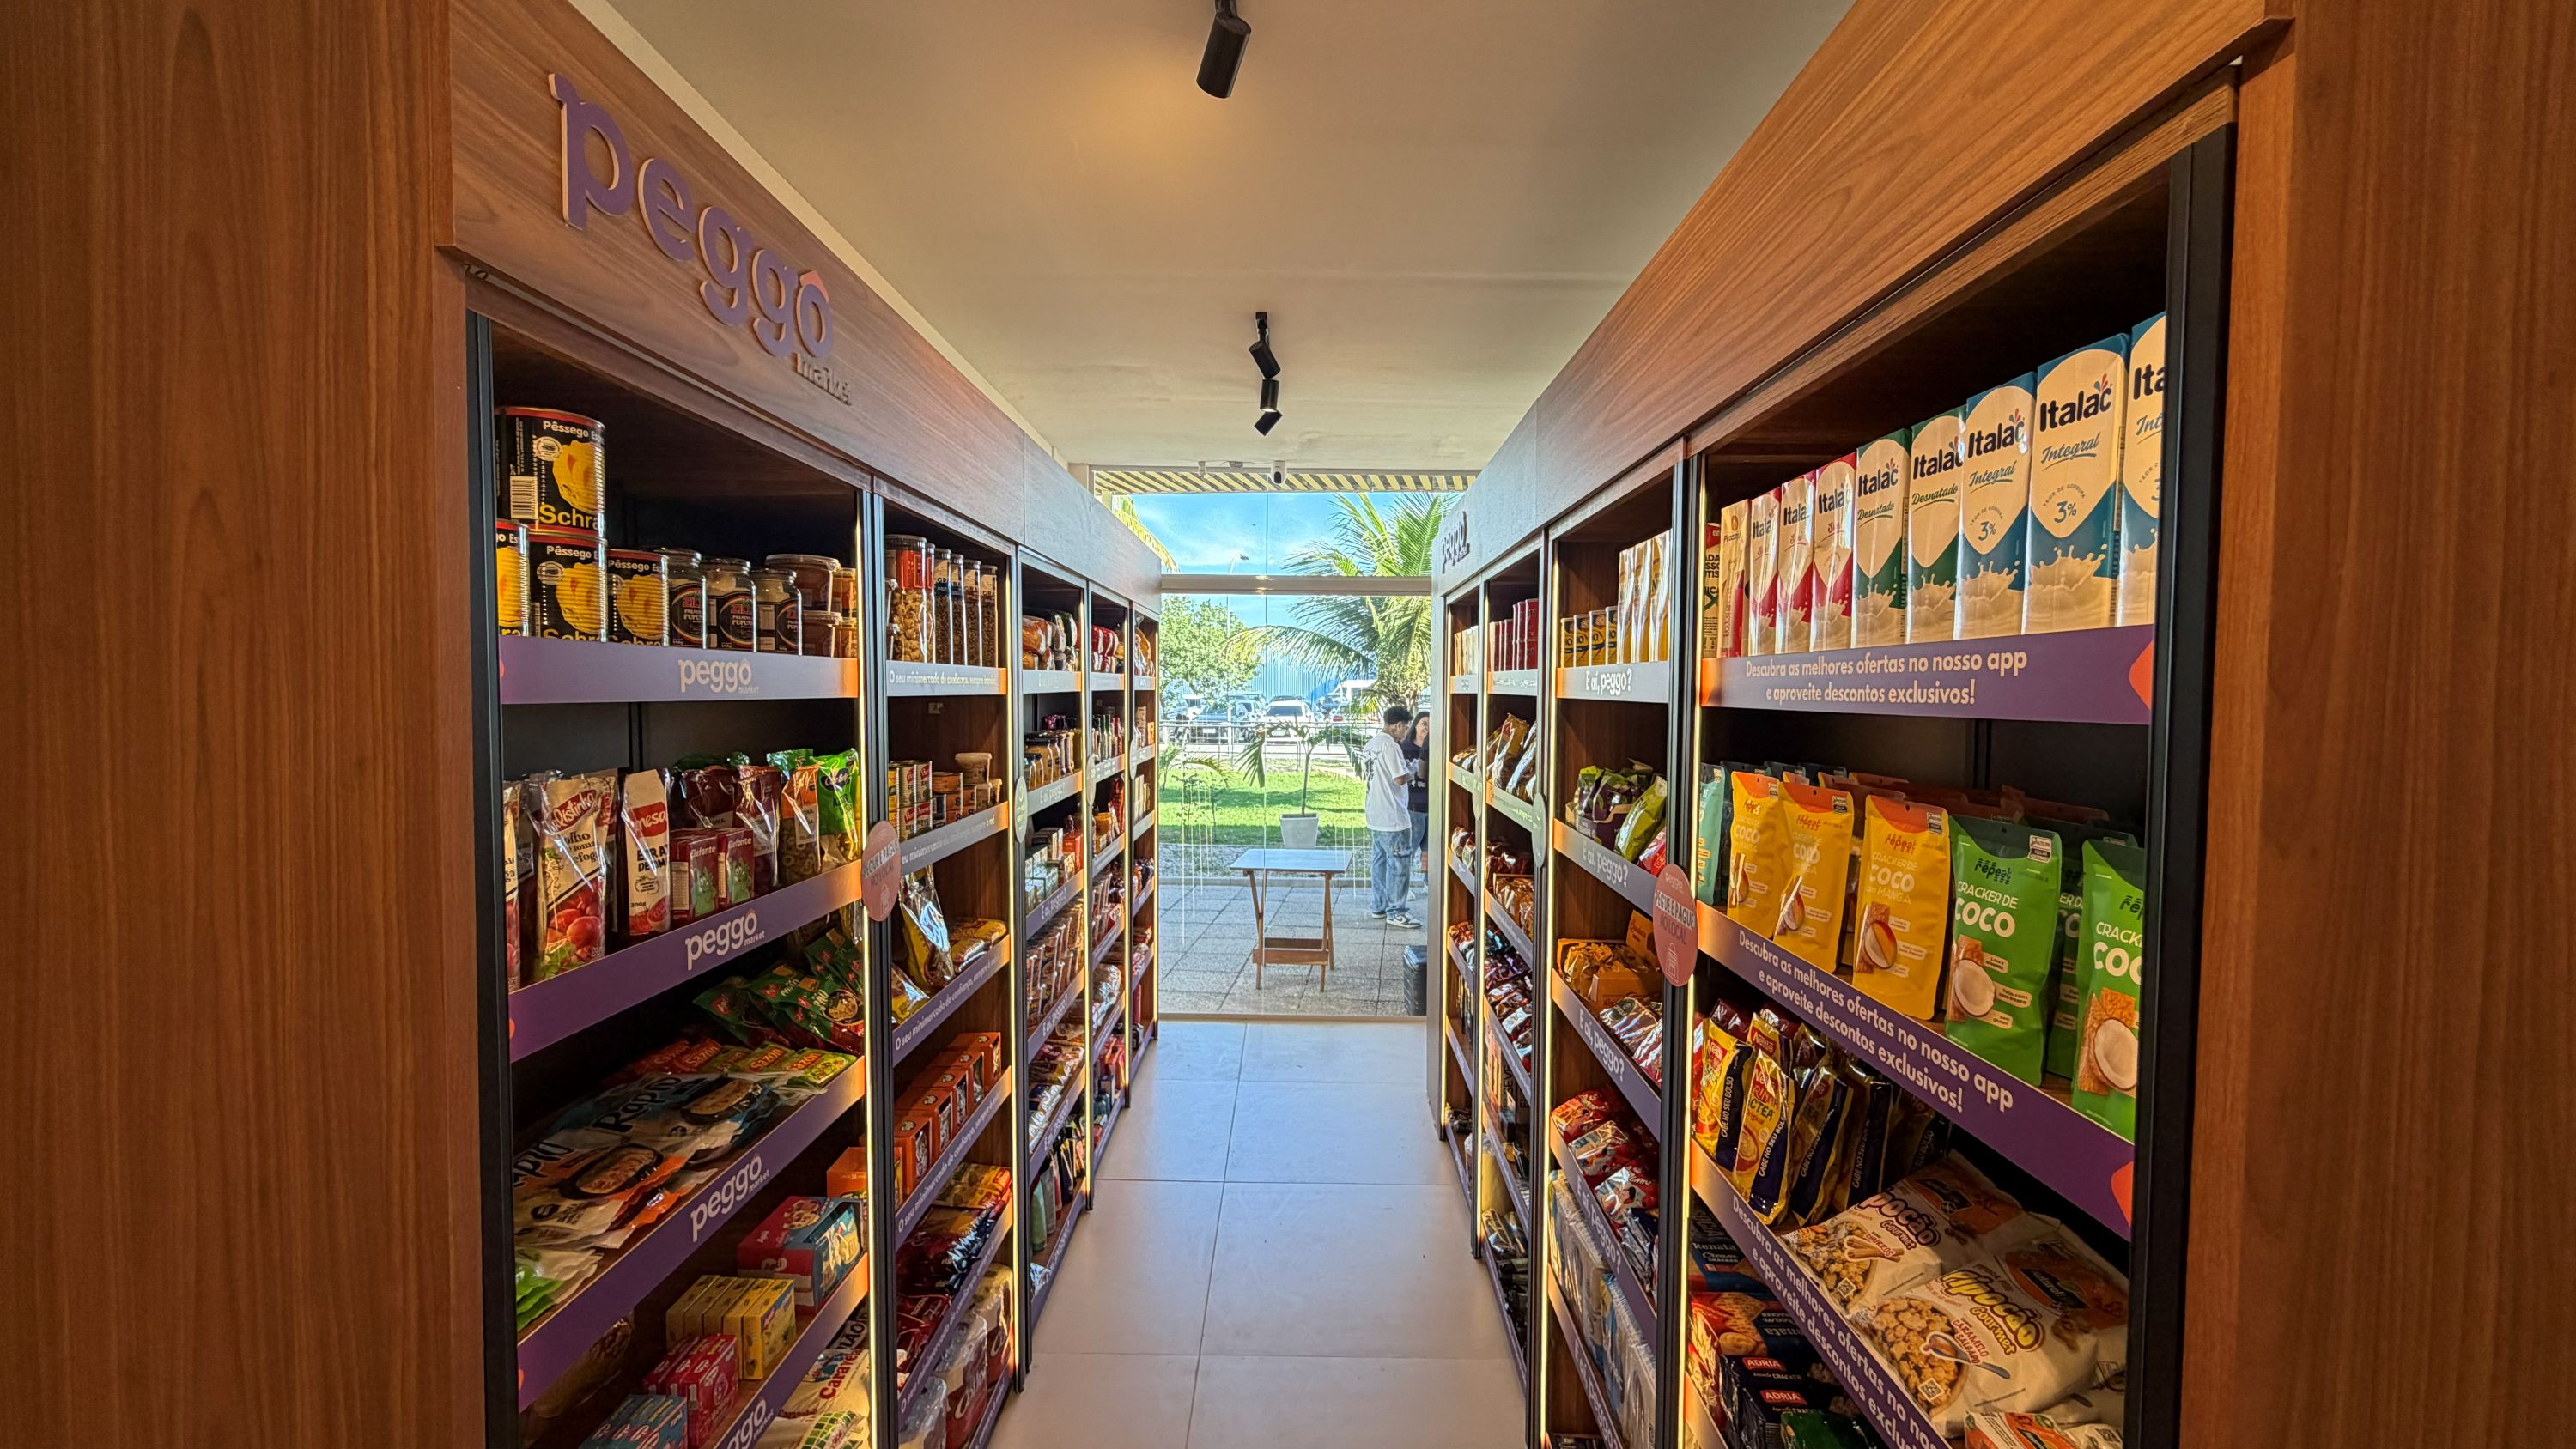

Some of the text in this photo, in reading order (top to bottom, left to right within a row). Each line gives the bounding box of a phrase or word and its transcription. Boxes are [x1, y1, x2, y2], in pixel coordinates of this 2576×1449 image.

[2039, 388, 2112, 433] Italac
[543, 421, 588, 438] Pêssego
[2040, 433, 2101, 464] Integral
[1858, 467, 1899, 498] Italac
[1969, 461, 2017, 488] Integral
[1911, 484, 1959, 506] Desnatado
[1783, 503, 1807, 526] Itala
[1857, 501, 1894, 522] Desnatado
[2054, 501, 2077, 524] 3%
[546, 545, 592, 560] Pêssego
[608, 560, 650, 572] Pêssego
[1746, 651, 2027, 677] Descubra as melhores ofertas no nosso app
[1585, 670, 1590, 690] E
[1765, 678, 1976, 706] e aproveite descontos exclusivos!
[1958, 880, 2019, 909] CRACKER DE
[744, 931, 765, 947] market
[896, 1037, 901, 1051] O
[902, 1032, 912, 1046] seu
[912, 1000, 945, 1037] minimercado
[1739, 930, 2014, 1113] Descubra as melhores ofertas no nosso app
[1759, 970, 1963, 1113] e aproveite descontos exclusivos!
[1759, 1154, 1770, 1177] CABE
[1765, 1144, 1773, 1157] NO
[1775, 1111, 1786, 1134] BOLS
[1801, 1155, 1810, 1178] CABE
[1852, 1168, 1861, 1188] CABE
[749, 1169, 769, 1194] market
[898, 1218, 903, 1233] O
[904, 1209, 914, 1225] seu
[914, 1161, 948, 1211] minimercado
[1865, 1233, 1896, 1258] CHURROS
[1733, 1195, 1772, 1254] Descubra
[1773, 1251, 1784, 1272] as
[1786, 1264, 1836, 1335] melhores
[1838, 1326, 1884, 1395] ofertas
[1887, 1388, 1906, 1422] no
[1752, 1247, 1759, 1262] e
[1759, 1255, 1806, 1323] aproveite
[1807, 1318, 1866, 1402] descontos
[1953, 1319, 1990, 1357] CARAMELO
[1956, 1333, 1981, 1364] SALGADO
[819, 1349, 860, 1399] Carave
[1747, 1358, 1782, 1368] ADRIA
[1765, 1391, 1800, 1401] ADRIA
